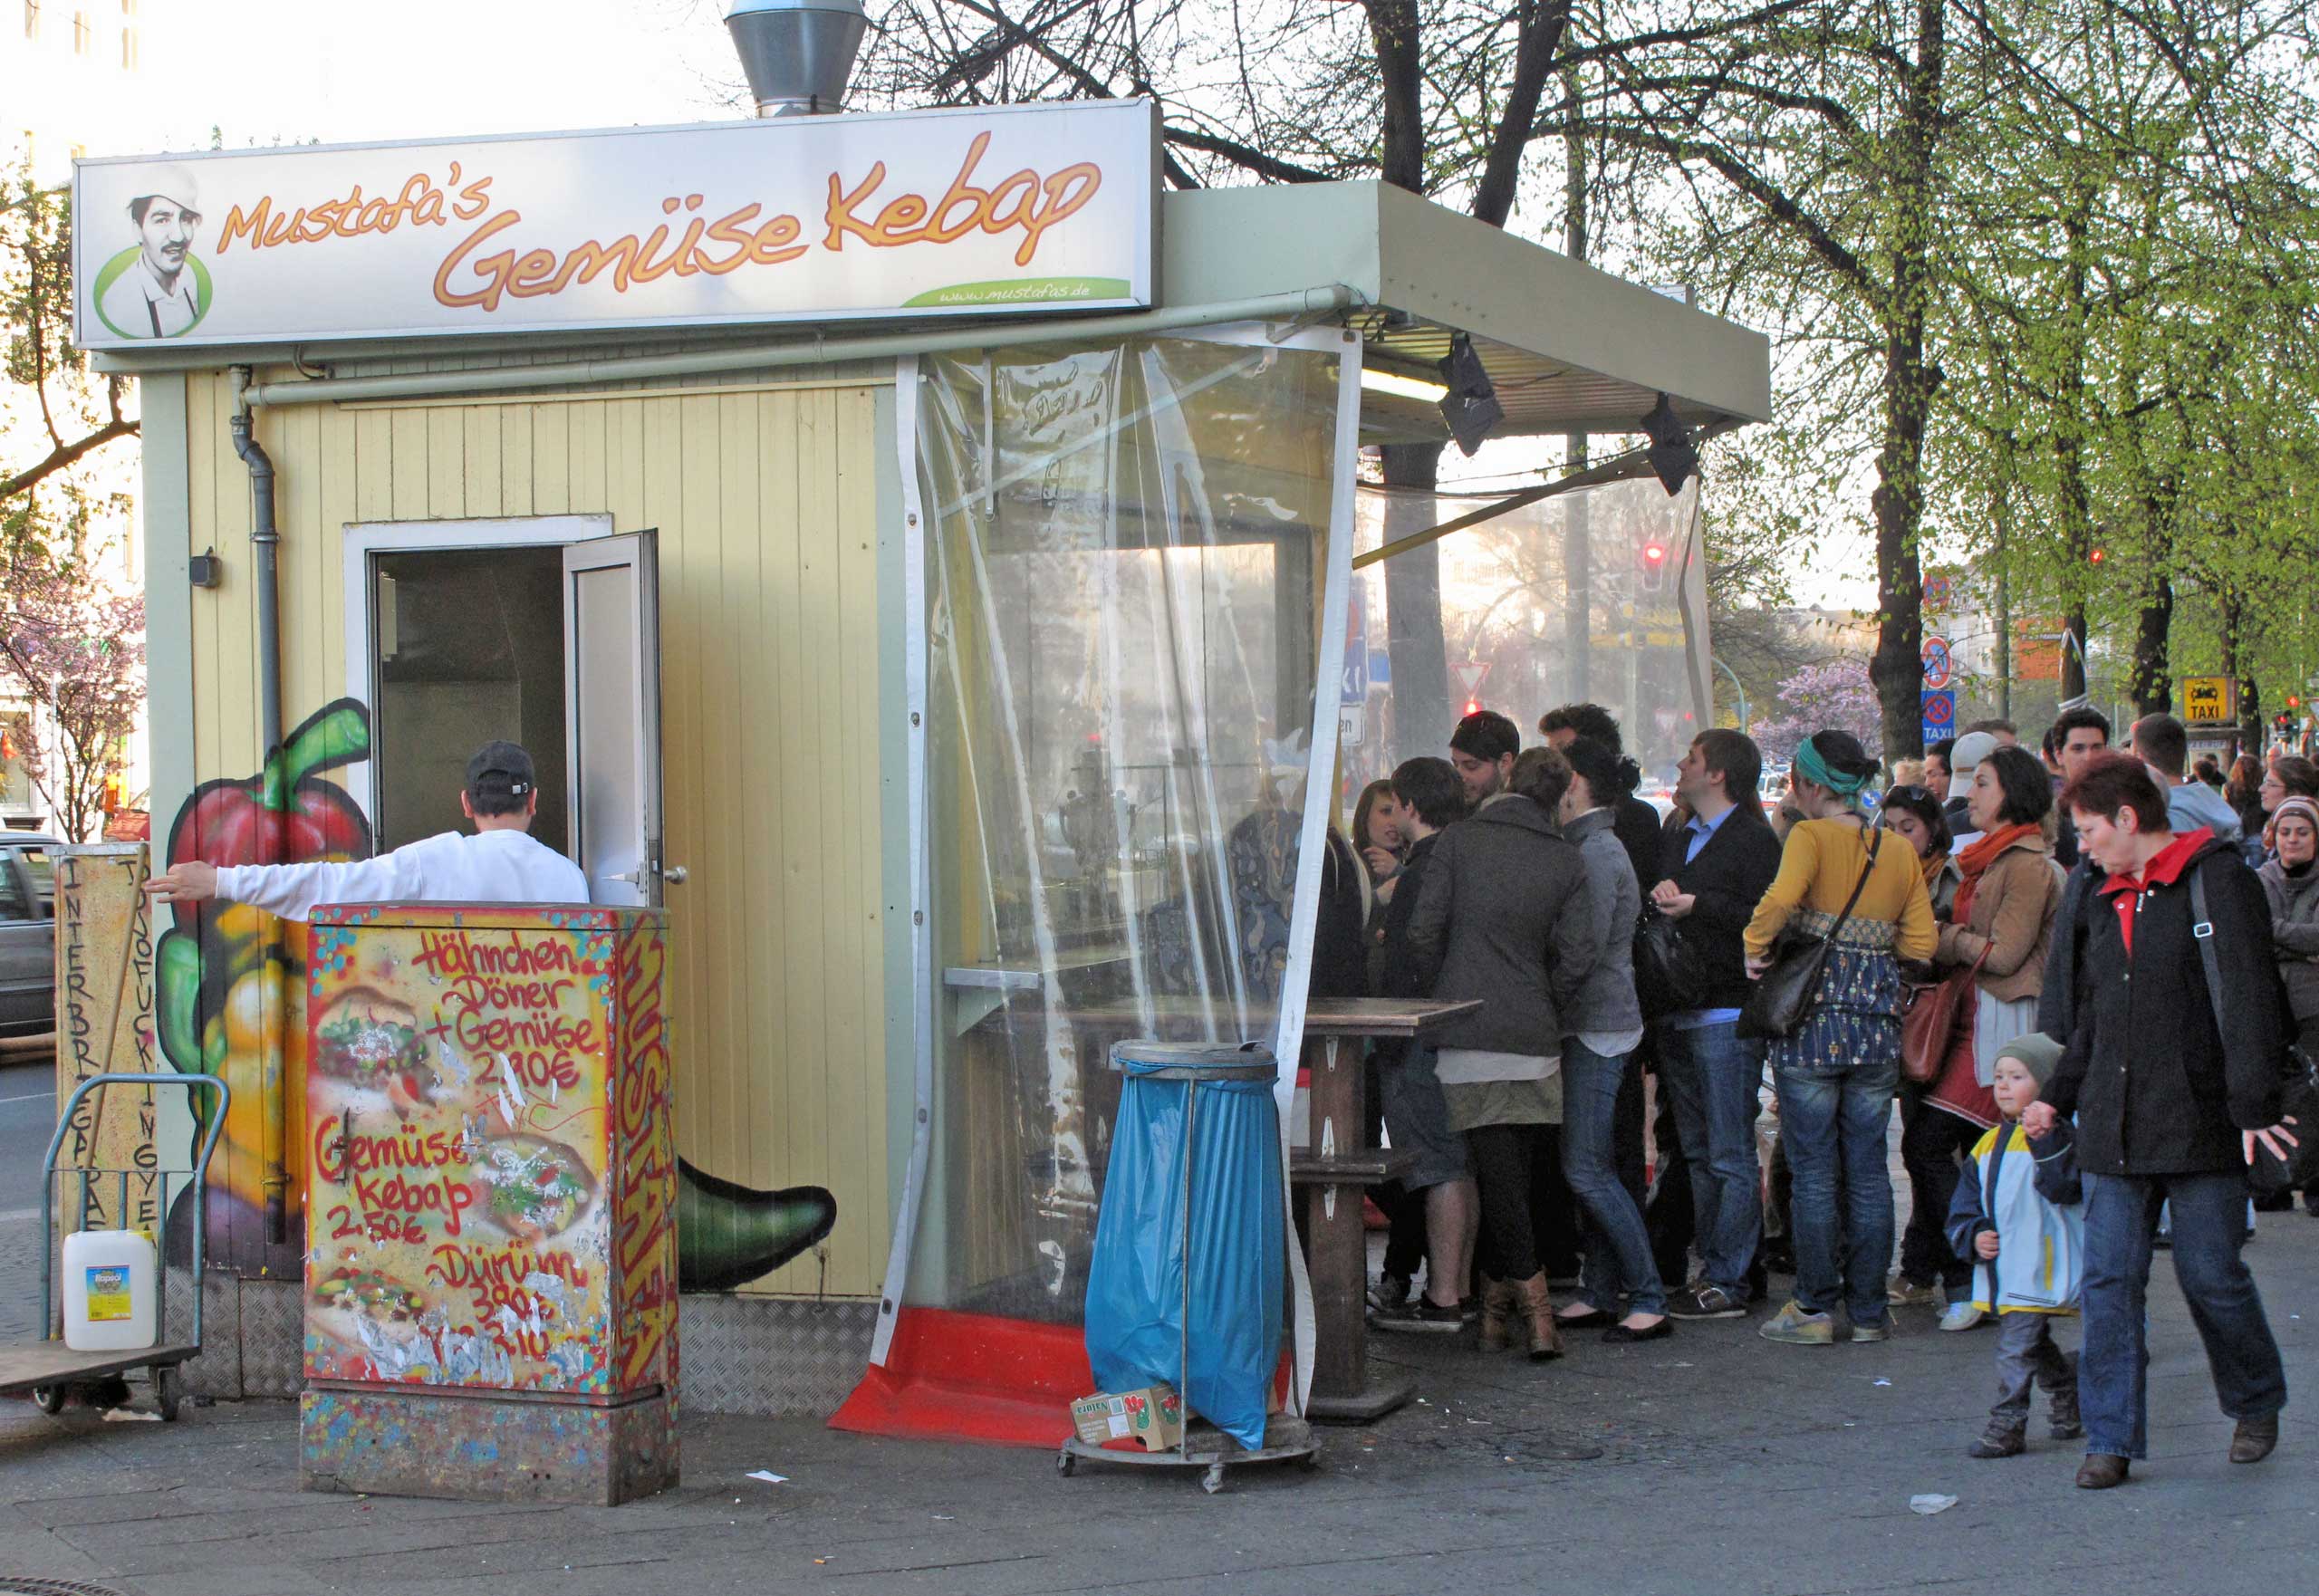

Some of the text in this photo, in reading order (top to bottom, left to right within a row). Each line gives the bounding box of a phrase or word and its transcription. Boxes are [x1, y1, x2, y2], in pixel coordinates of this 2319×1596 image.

[217, 160, 494, 255] Mustafa's
[433, 130, 1102, 312] Gemüse Kebap
[939, 283, 1091, 303] www.mustafas.de
[1923, 727, 1952, 740] TAXI
[2190, 705, 2219, 720] TAXI
[411, 930, 578, 976] Hähnchen
[441, 974, 574, 1011] Döner
[457, 1007, 601, 1053] Gemüse
[314, 1115, 469, 1183] Gemüse
[424, 1240, 588, 1288] Dürüm
